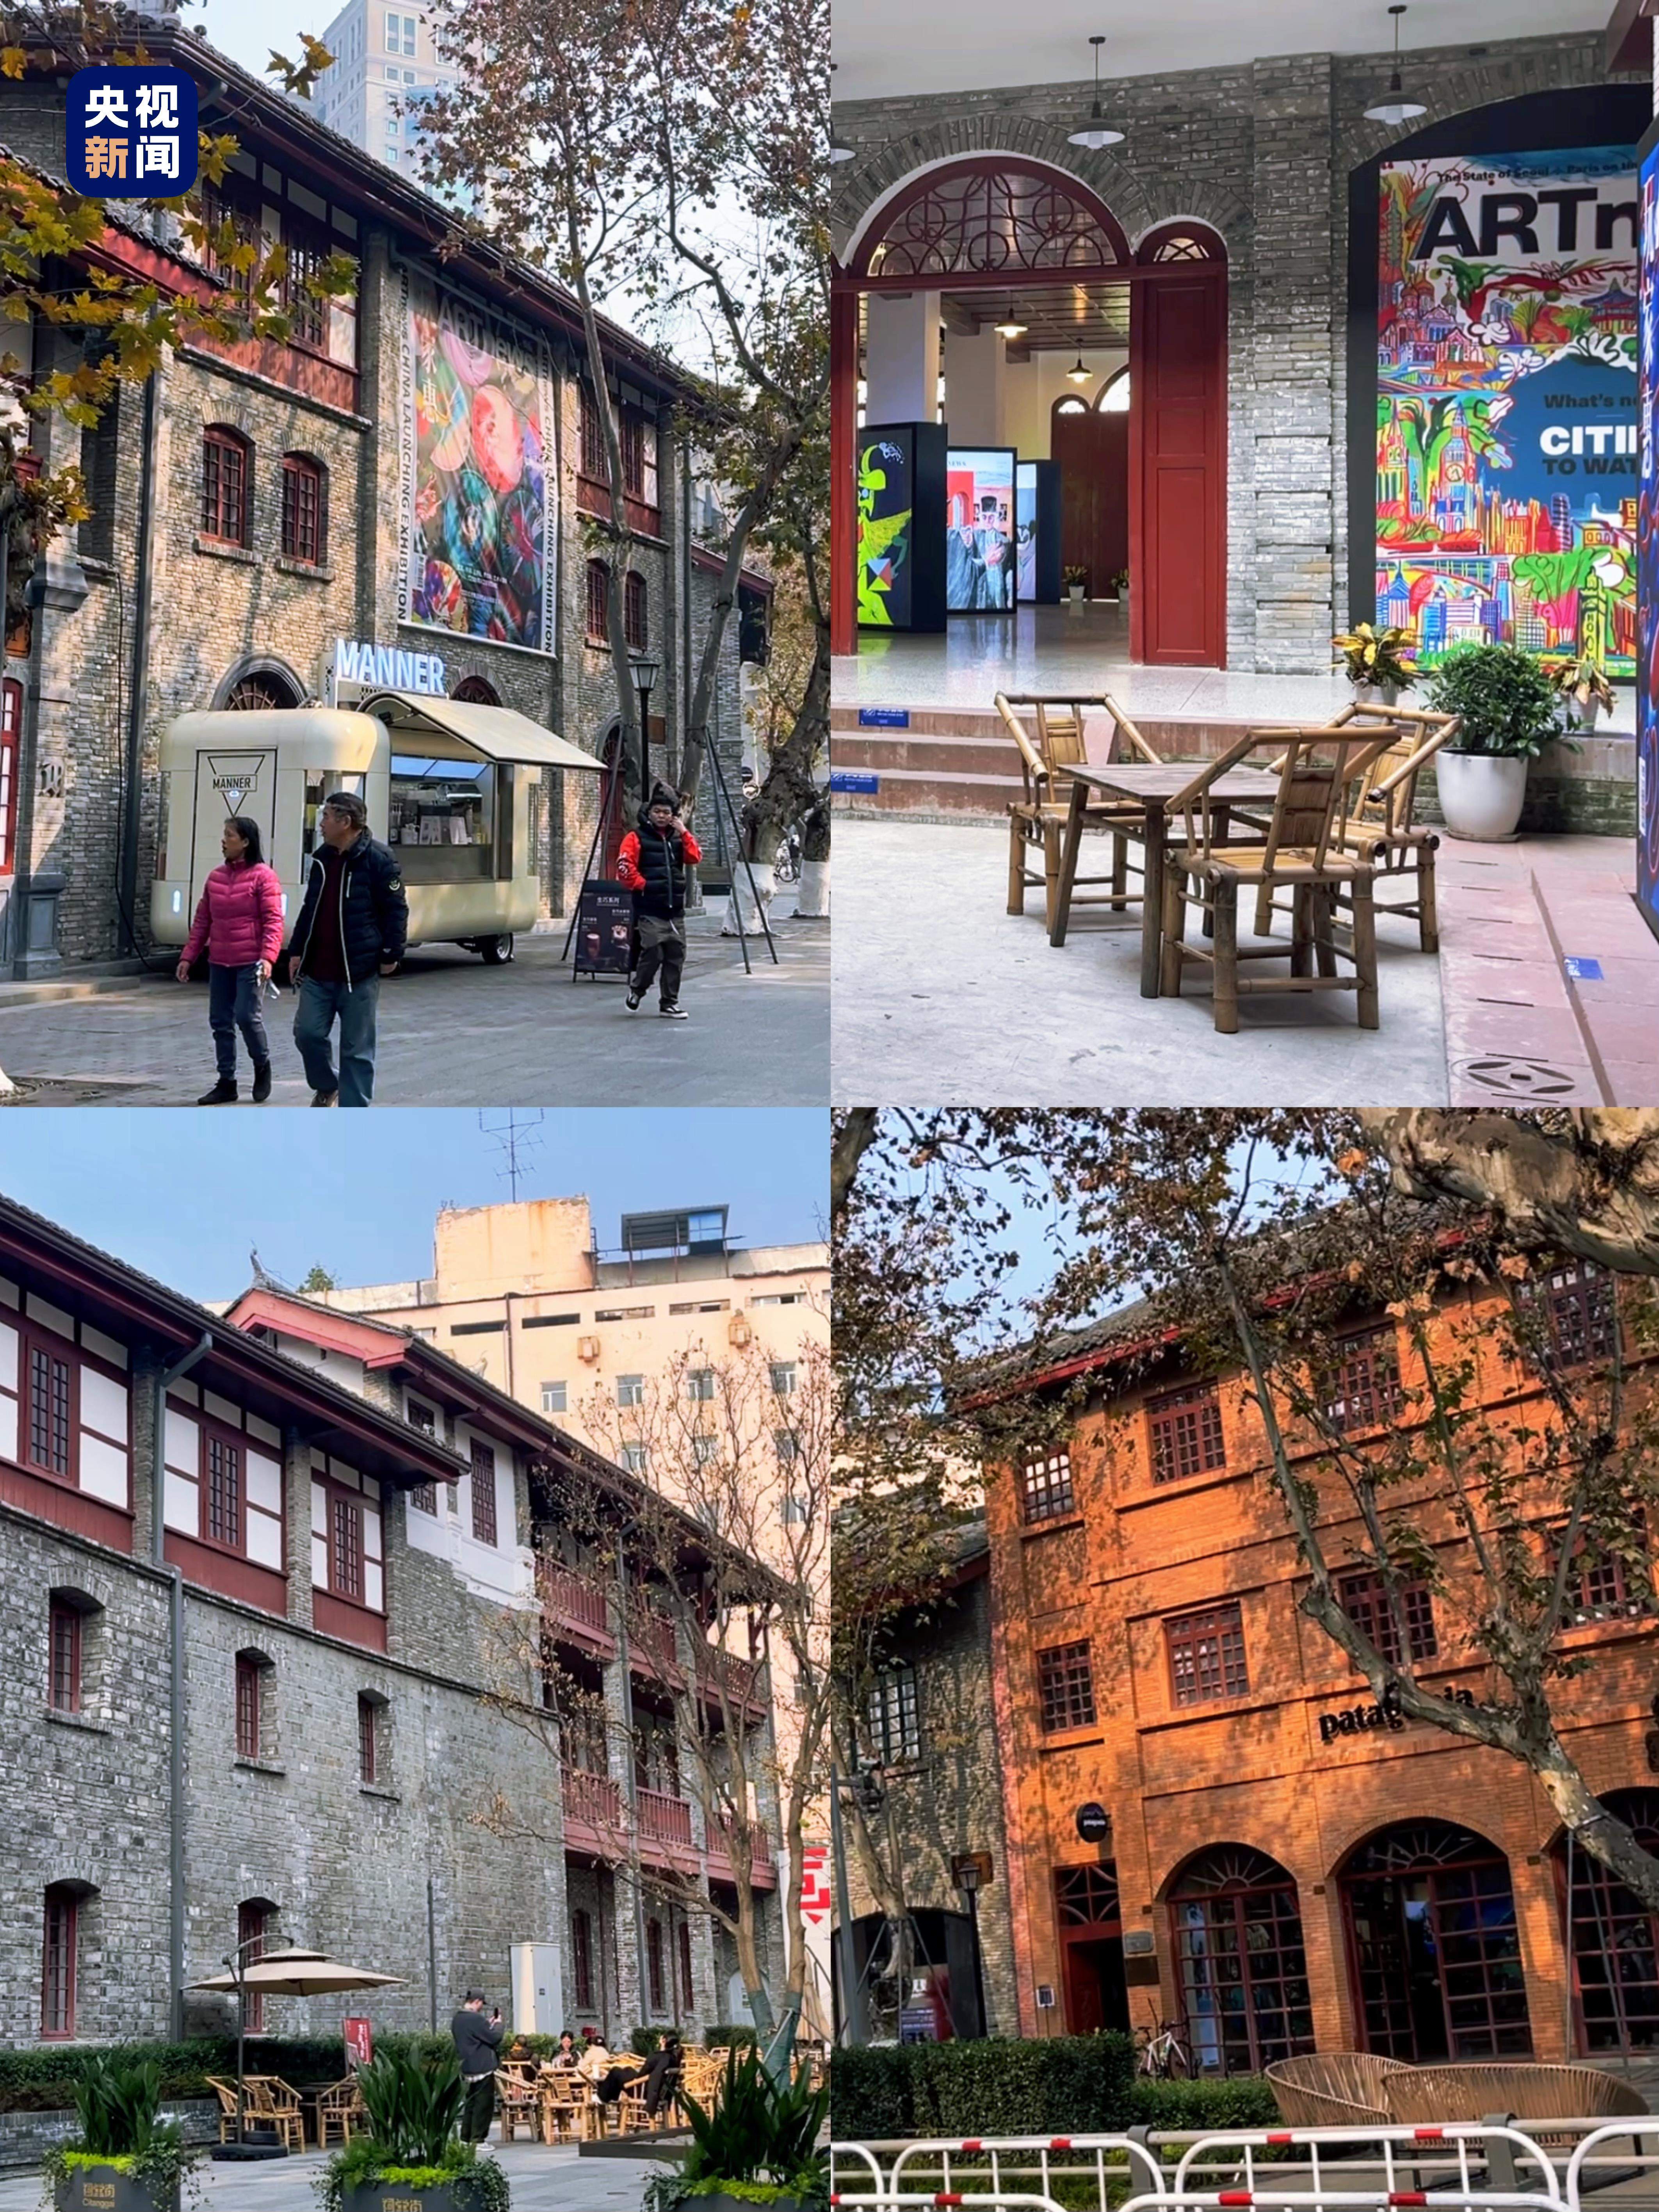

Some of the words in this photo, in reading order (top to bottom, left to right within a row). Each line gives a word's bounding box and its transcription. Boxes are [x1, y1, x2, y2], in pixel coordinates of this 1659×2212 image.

[1438, 173, 1461, 184] The
[1463, 171, 1495, 181] State
[1498, 169, 1511, 178] of
[402, 344, 411, 397] CHINA
[1544, 393, 1614, 409] What's
[401, 404, 411, 509] LAUNCHING
[1543, 458, 1576, 475] TO
[397, 514, 409, 620] EXHIBITION
[545, 562, 554, 653] EXHIBITION
[336, 638, 445, 694] MANNER
[213, 777, 251, 790] MANNER
